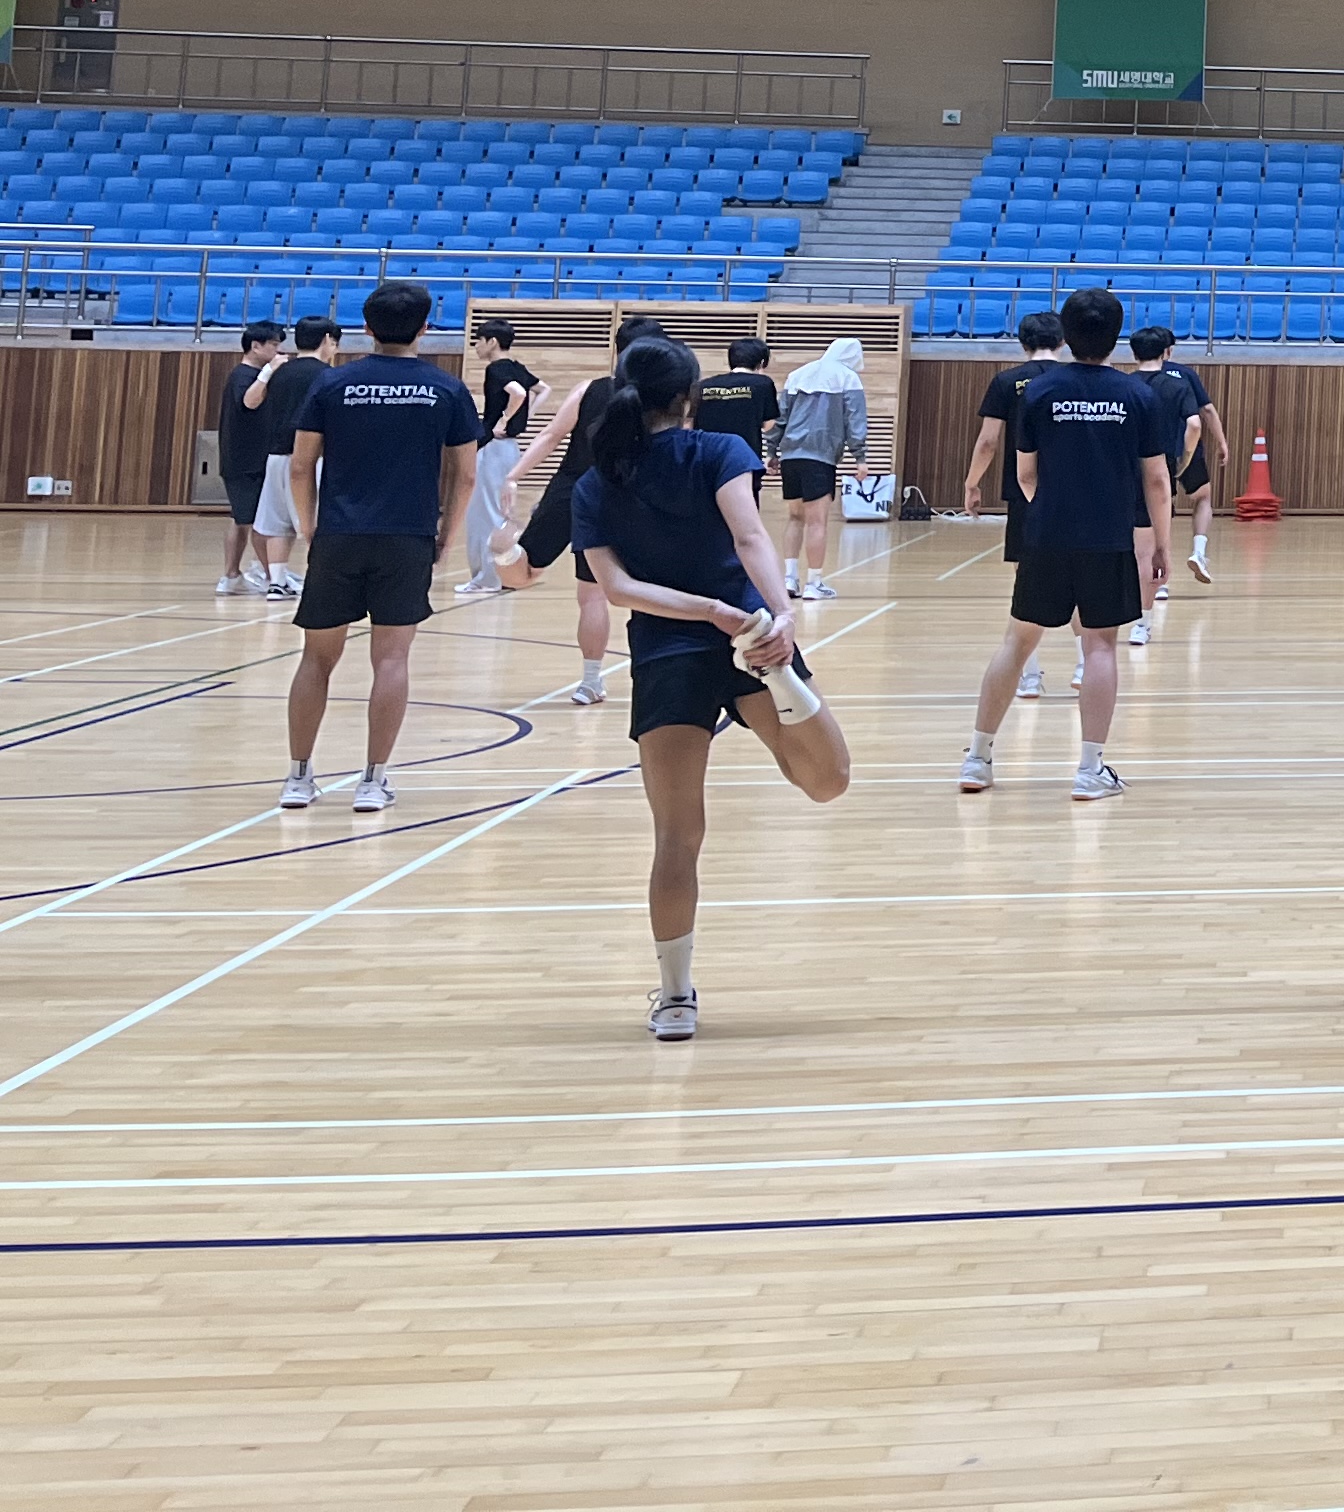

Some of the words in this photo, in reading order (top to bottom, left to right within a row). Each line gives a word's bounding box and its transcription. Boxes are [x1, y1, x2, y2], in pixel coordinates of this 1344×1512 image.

[1082, 70, 1118, 88] SMU
[344, 385, 439, 399] POTENTIAL
[1052, 400, 1127, 414] POTENTIAL
